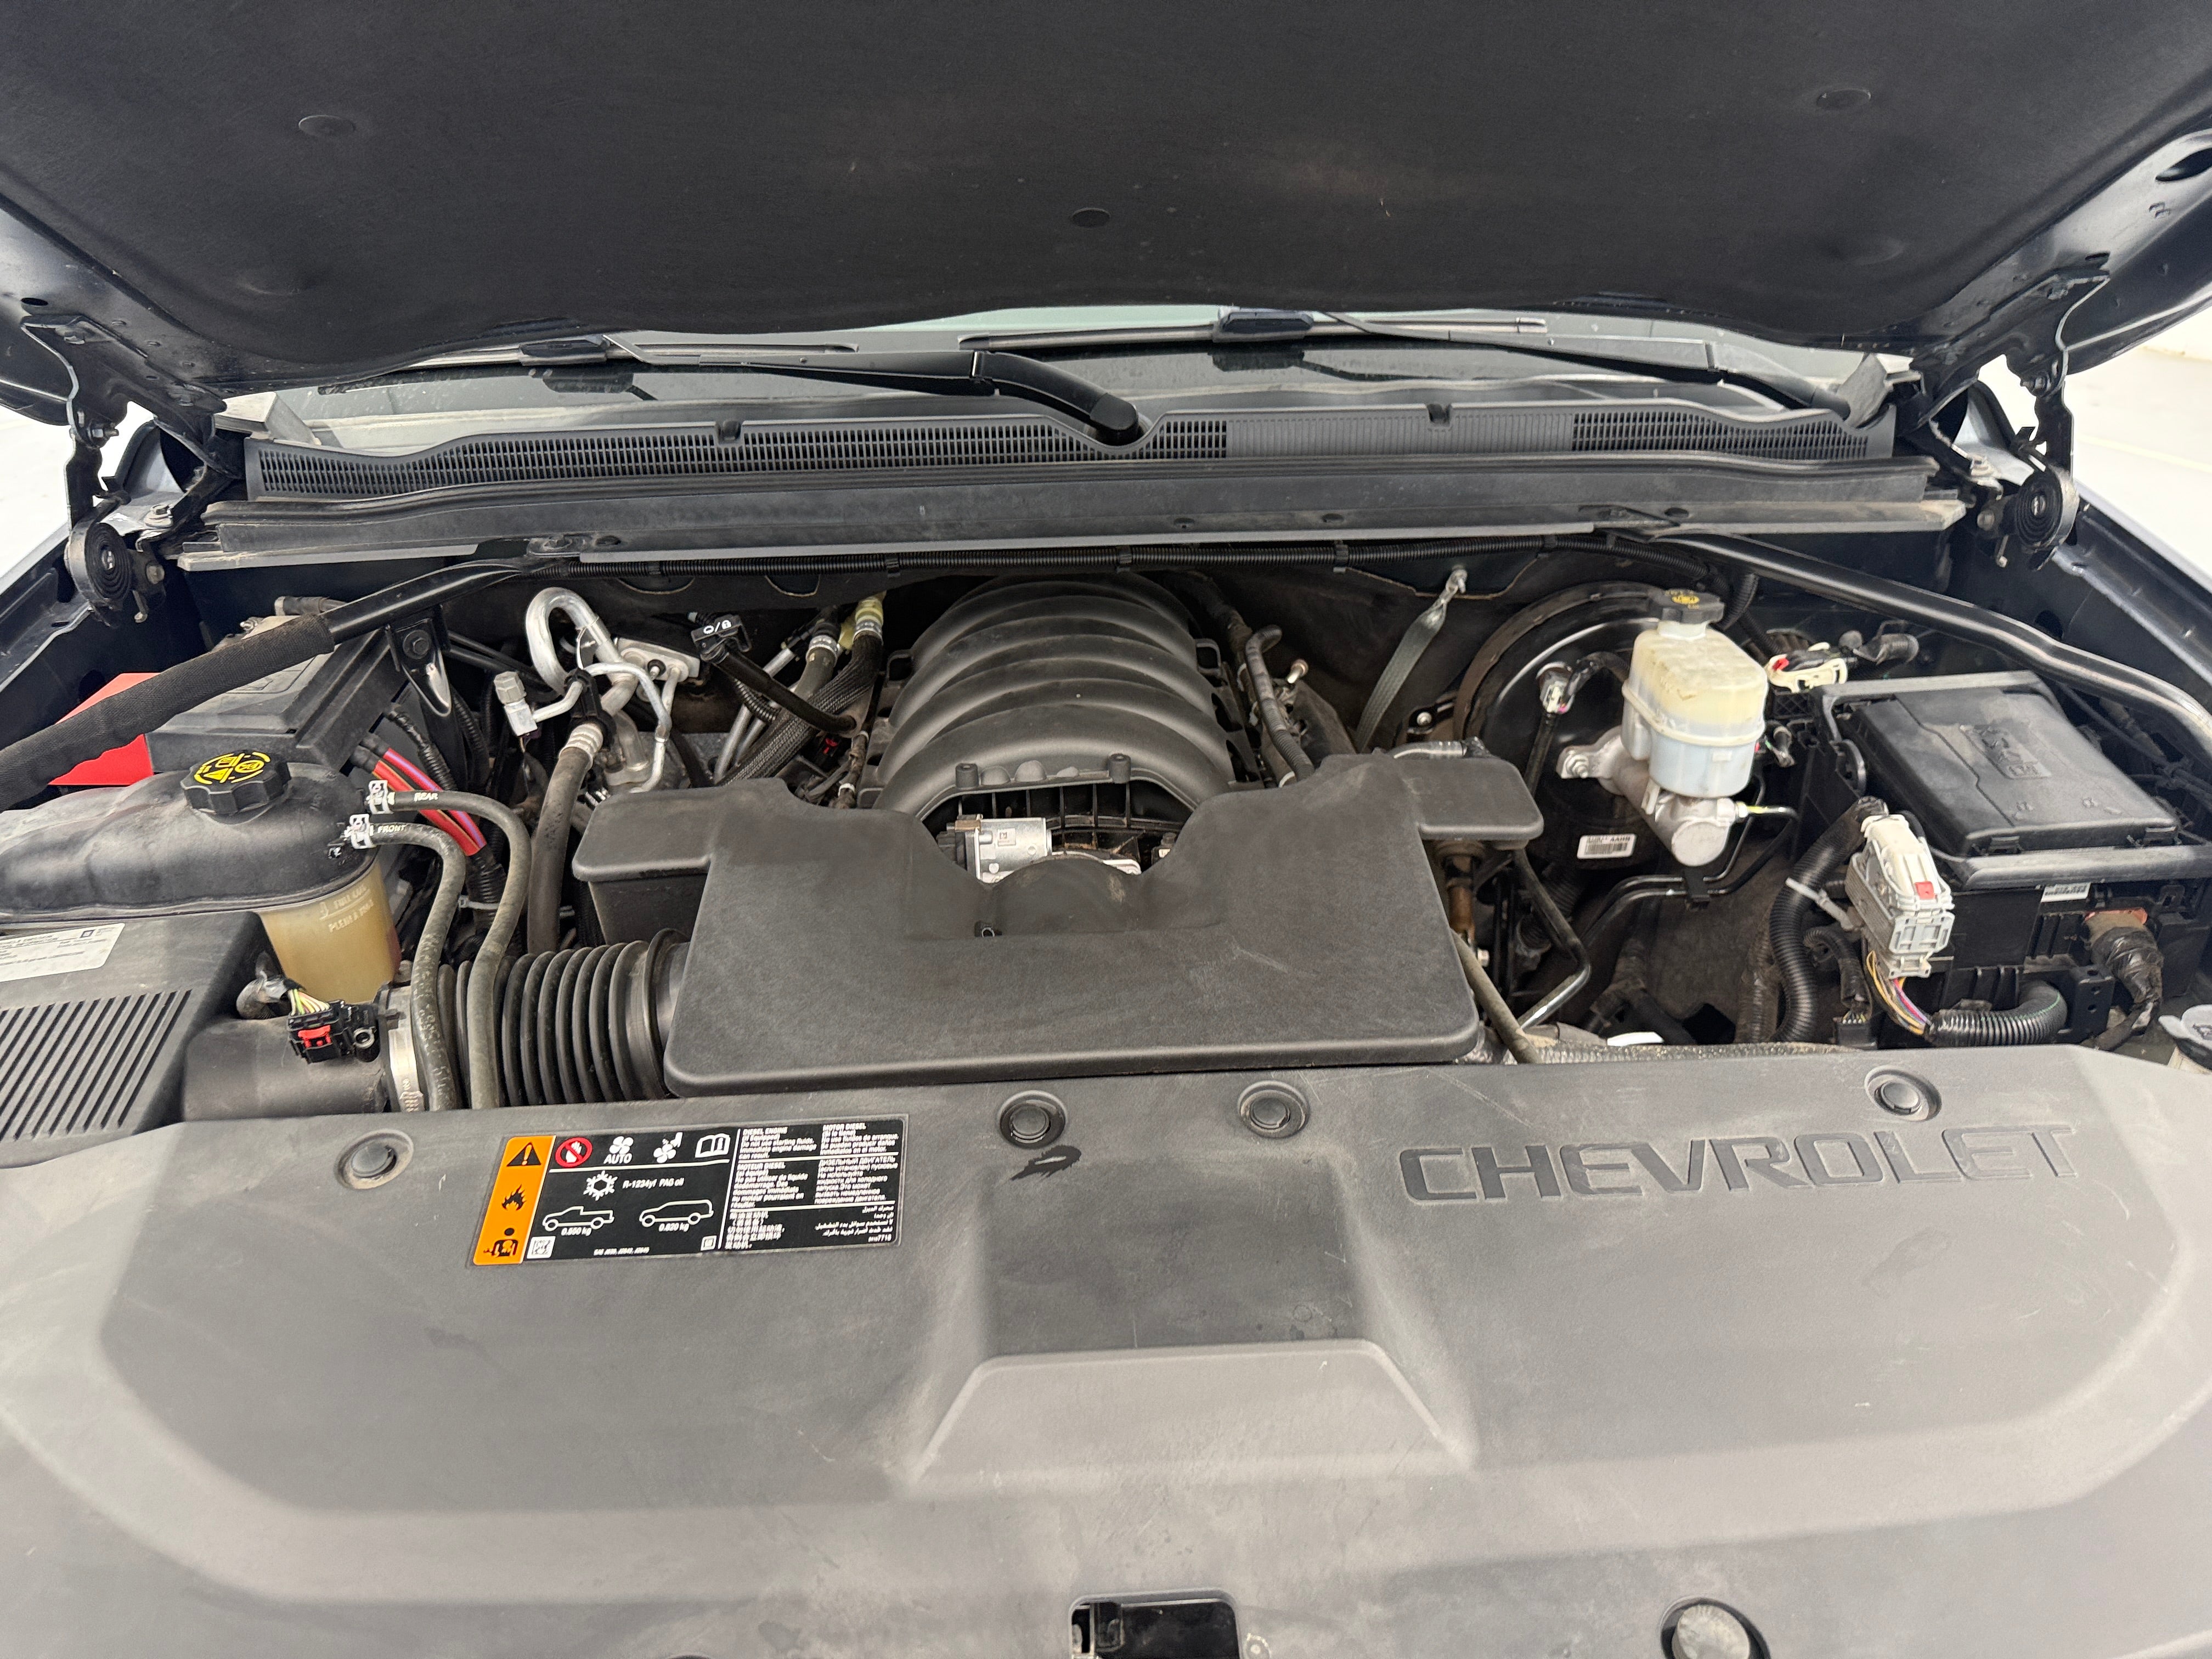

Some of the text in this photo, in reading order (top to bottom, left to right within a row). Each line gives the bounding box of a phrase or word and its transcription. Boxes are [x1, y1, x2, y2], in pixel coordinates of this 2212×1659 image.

[414, 792, 438, 802] REAR
[377, 825, 407, 833] FRONT
[765, 1126, 788, 1135] ENGINE
[772, 1145, 792, 1153] engine
[604, 1154, 633, 1164] AUTO
[859, 1156, 895, 1165] ДВИГАТЕЛЬ
[1399, 1124, 2080, 1204] CHEVROLET
[737, 1161, 786, 1171] MOTEUR DIESEL
[623, 1178, 658, 1189] R-1234yf
[659, 1178, 674, 1188] PAG
[582, 1227, 592, 1237] kg
[680, 1222, 689, 1232] kg
